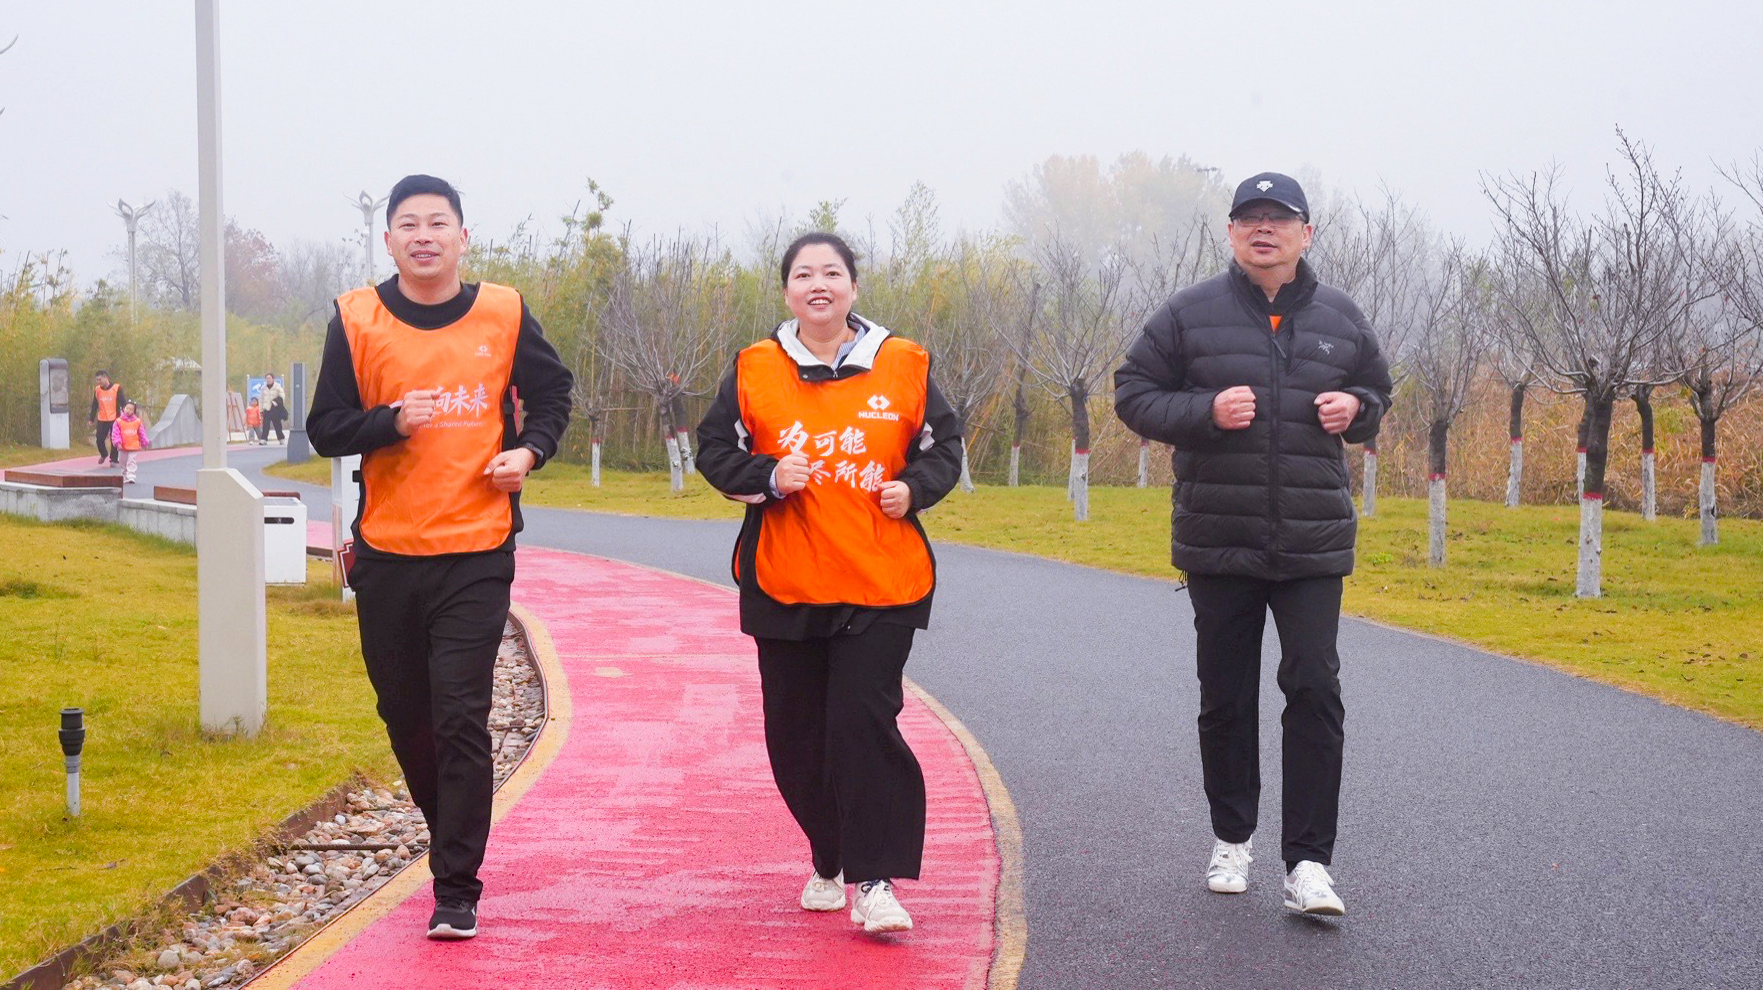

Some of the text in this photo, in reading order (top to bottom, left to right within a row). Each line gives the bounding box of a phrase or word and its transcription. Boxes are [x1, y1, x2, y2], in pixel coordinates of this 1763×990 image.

[389, 382, 488, 418] 向未来
[858, 411, 899, 421] NUCLEON
[440, 420, 463, 428] Shared
[777, 420, 866, 456] 为可能
[809, 460, 885, 492] 尽所能
